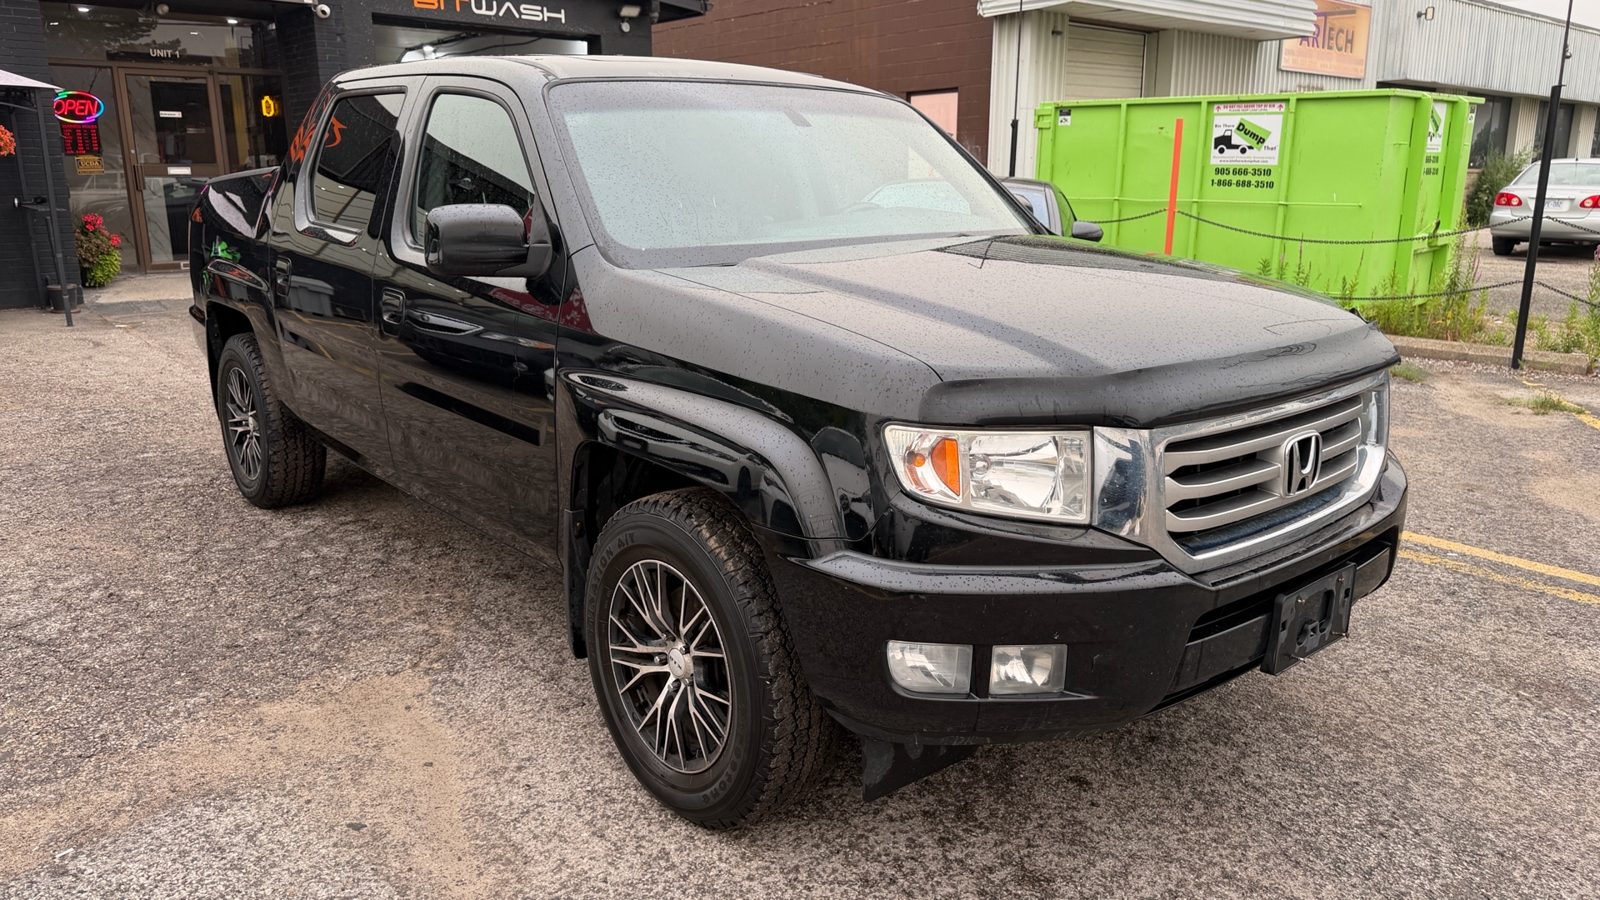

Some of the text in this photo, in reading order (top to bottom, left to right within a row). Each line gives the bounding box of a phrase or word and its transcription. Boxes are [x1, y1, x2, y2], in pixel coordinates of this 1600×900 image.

[149, 48, 180, 59] UNIT 1
[53, 99, 98, 116] OPEN
[1236, 121, 1266, 146] Dump
[1214, 167, 1272, 177] 905 666-3510
